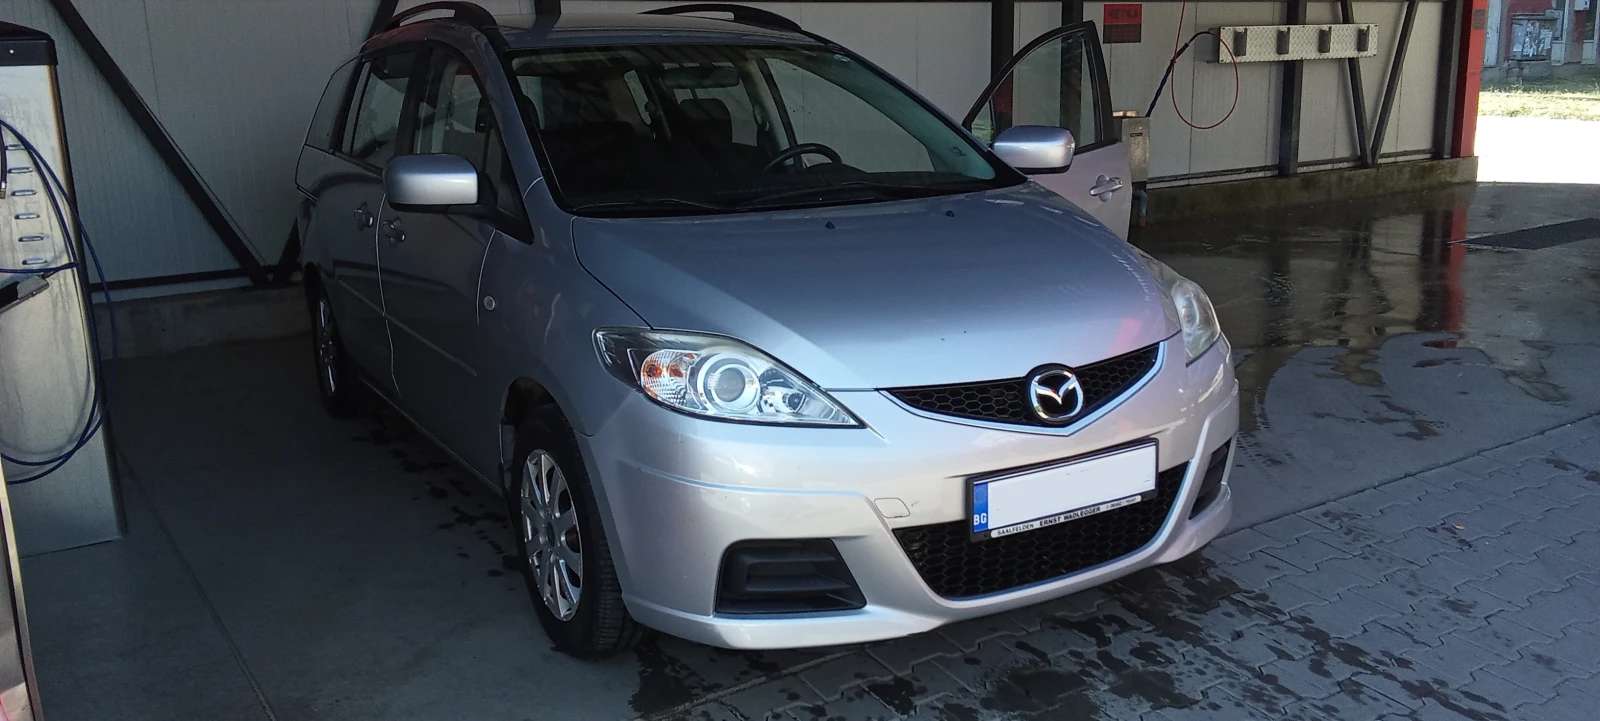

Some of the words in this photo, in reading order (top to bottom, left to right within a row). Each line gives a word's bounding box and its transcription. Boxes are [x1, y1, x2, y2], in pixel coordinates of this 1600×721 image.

[974, 512, 987, 526] BG
[997, 523, 1034, 536] SAALFELDEN
[1039, 516, 1062, 527] ERNST
